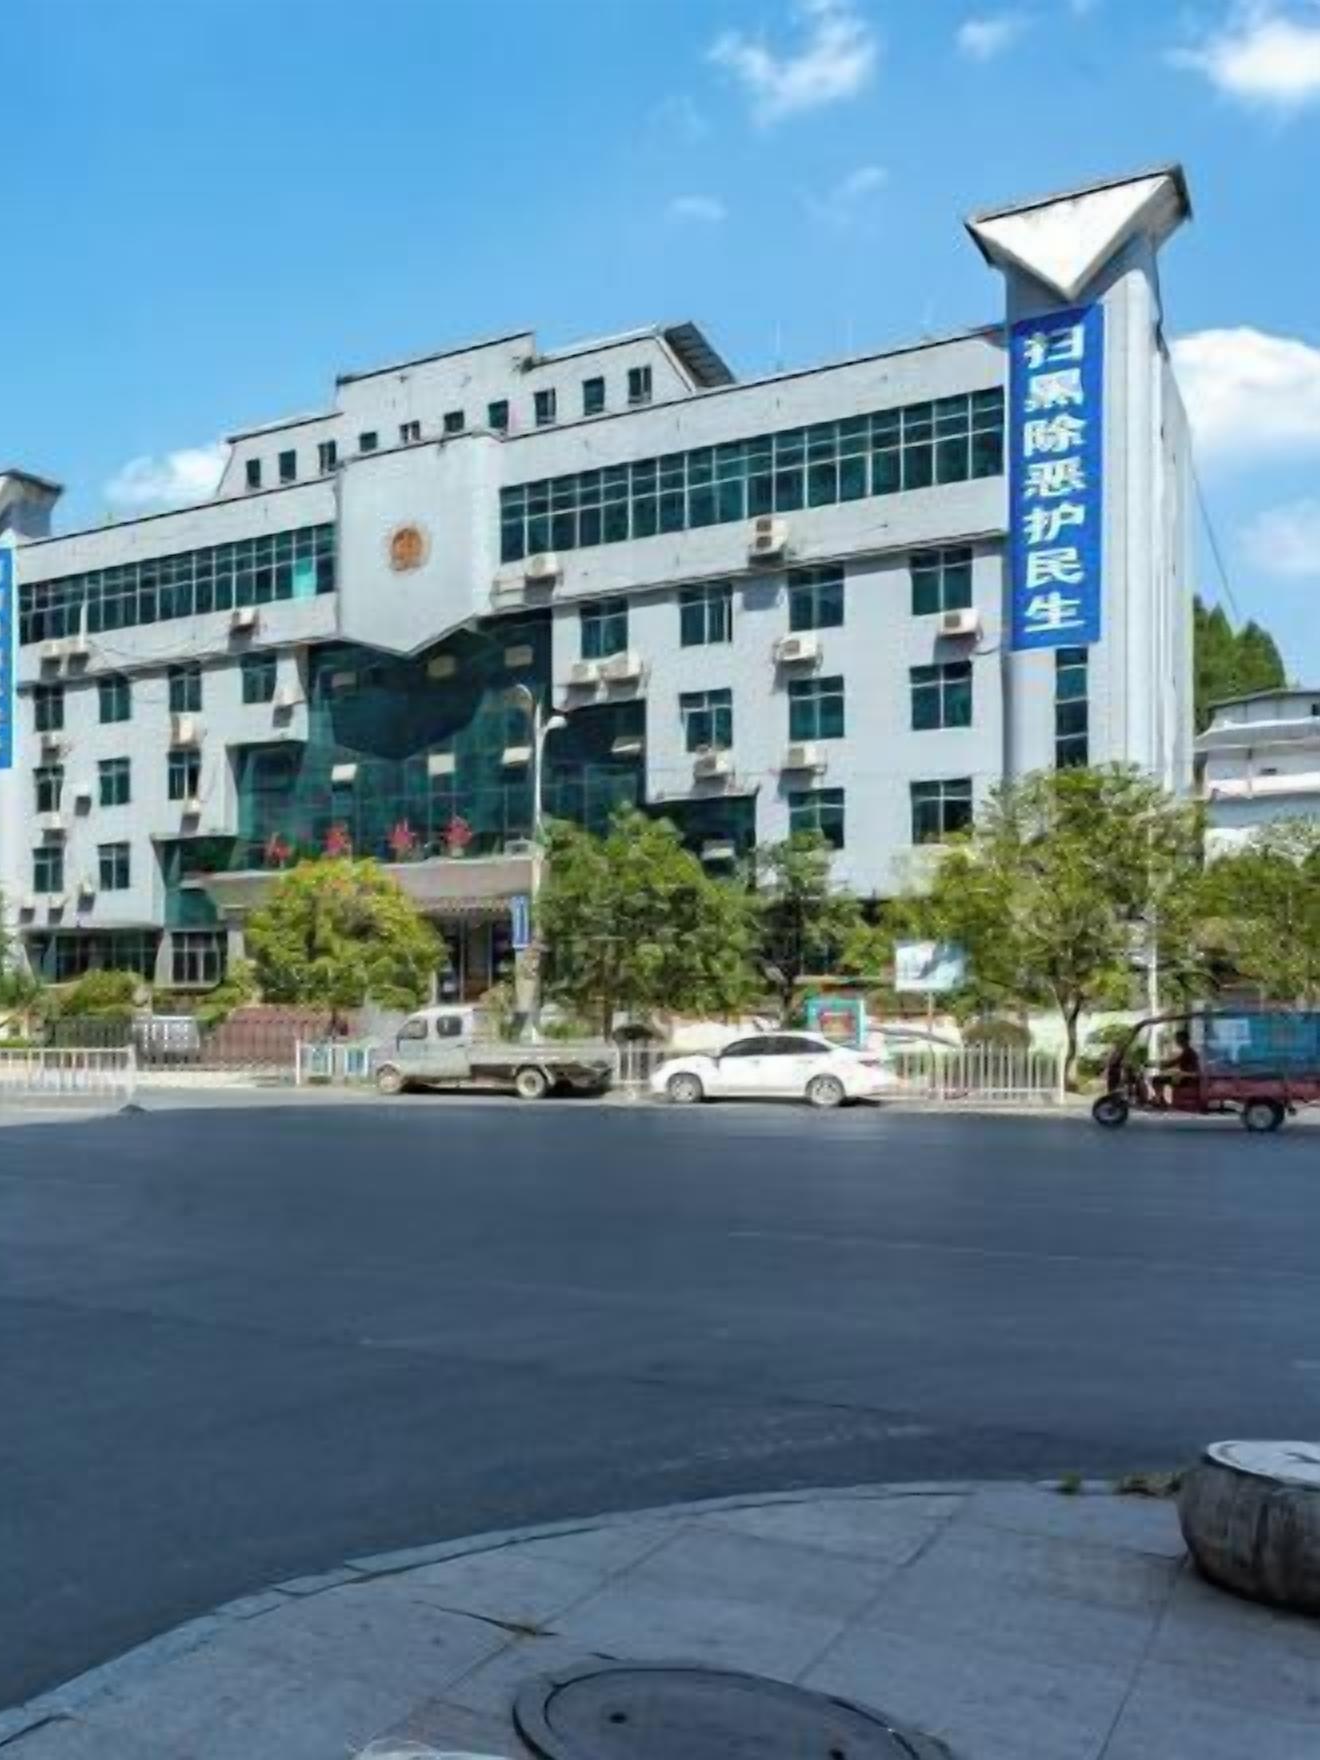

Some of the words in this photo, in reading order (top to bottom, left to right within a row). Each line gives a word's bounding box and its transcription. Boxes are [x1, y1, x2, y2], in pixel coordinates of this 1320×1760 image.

[1022, 322, 1088, 634] 扫黑除恶护民生
